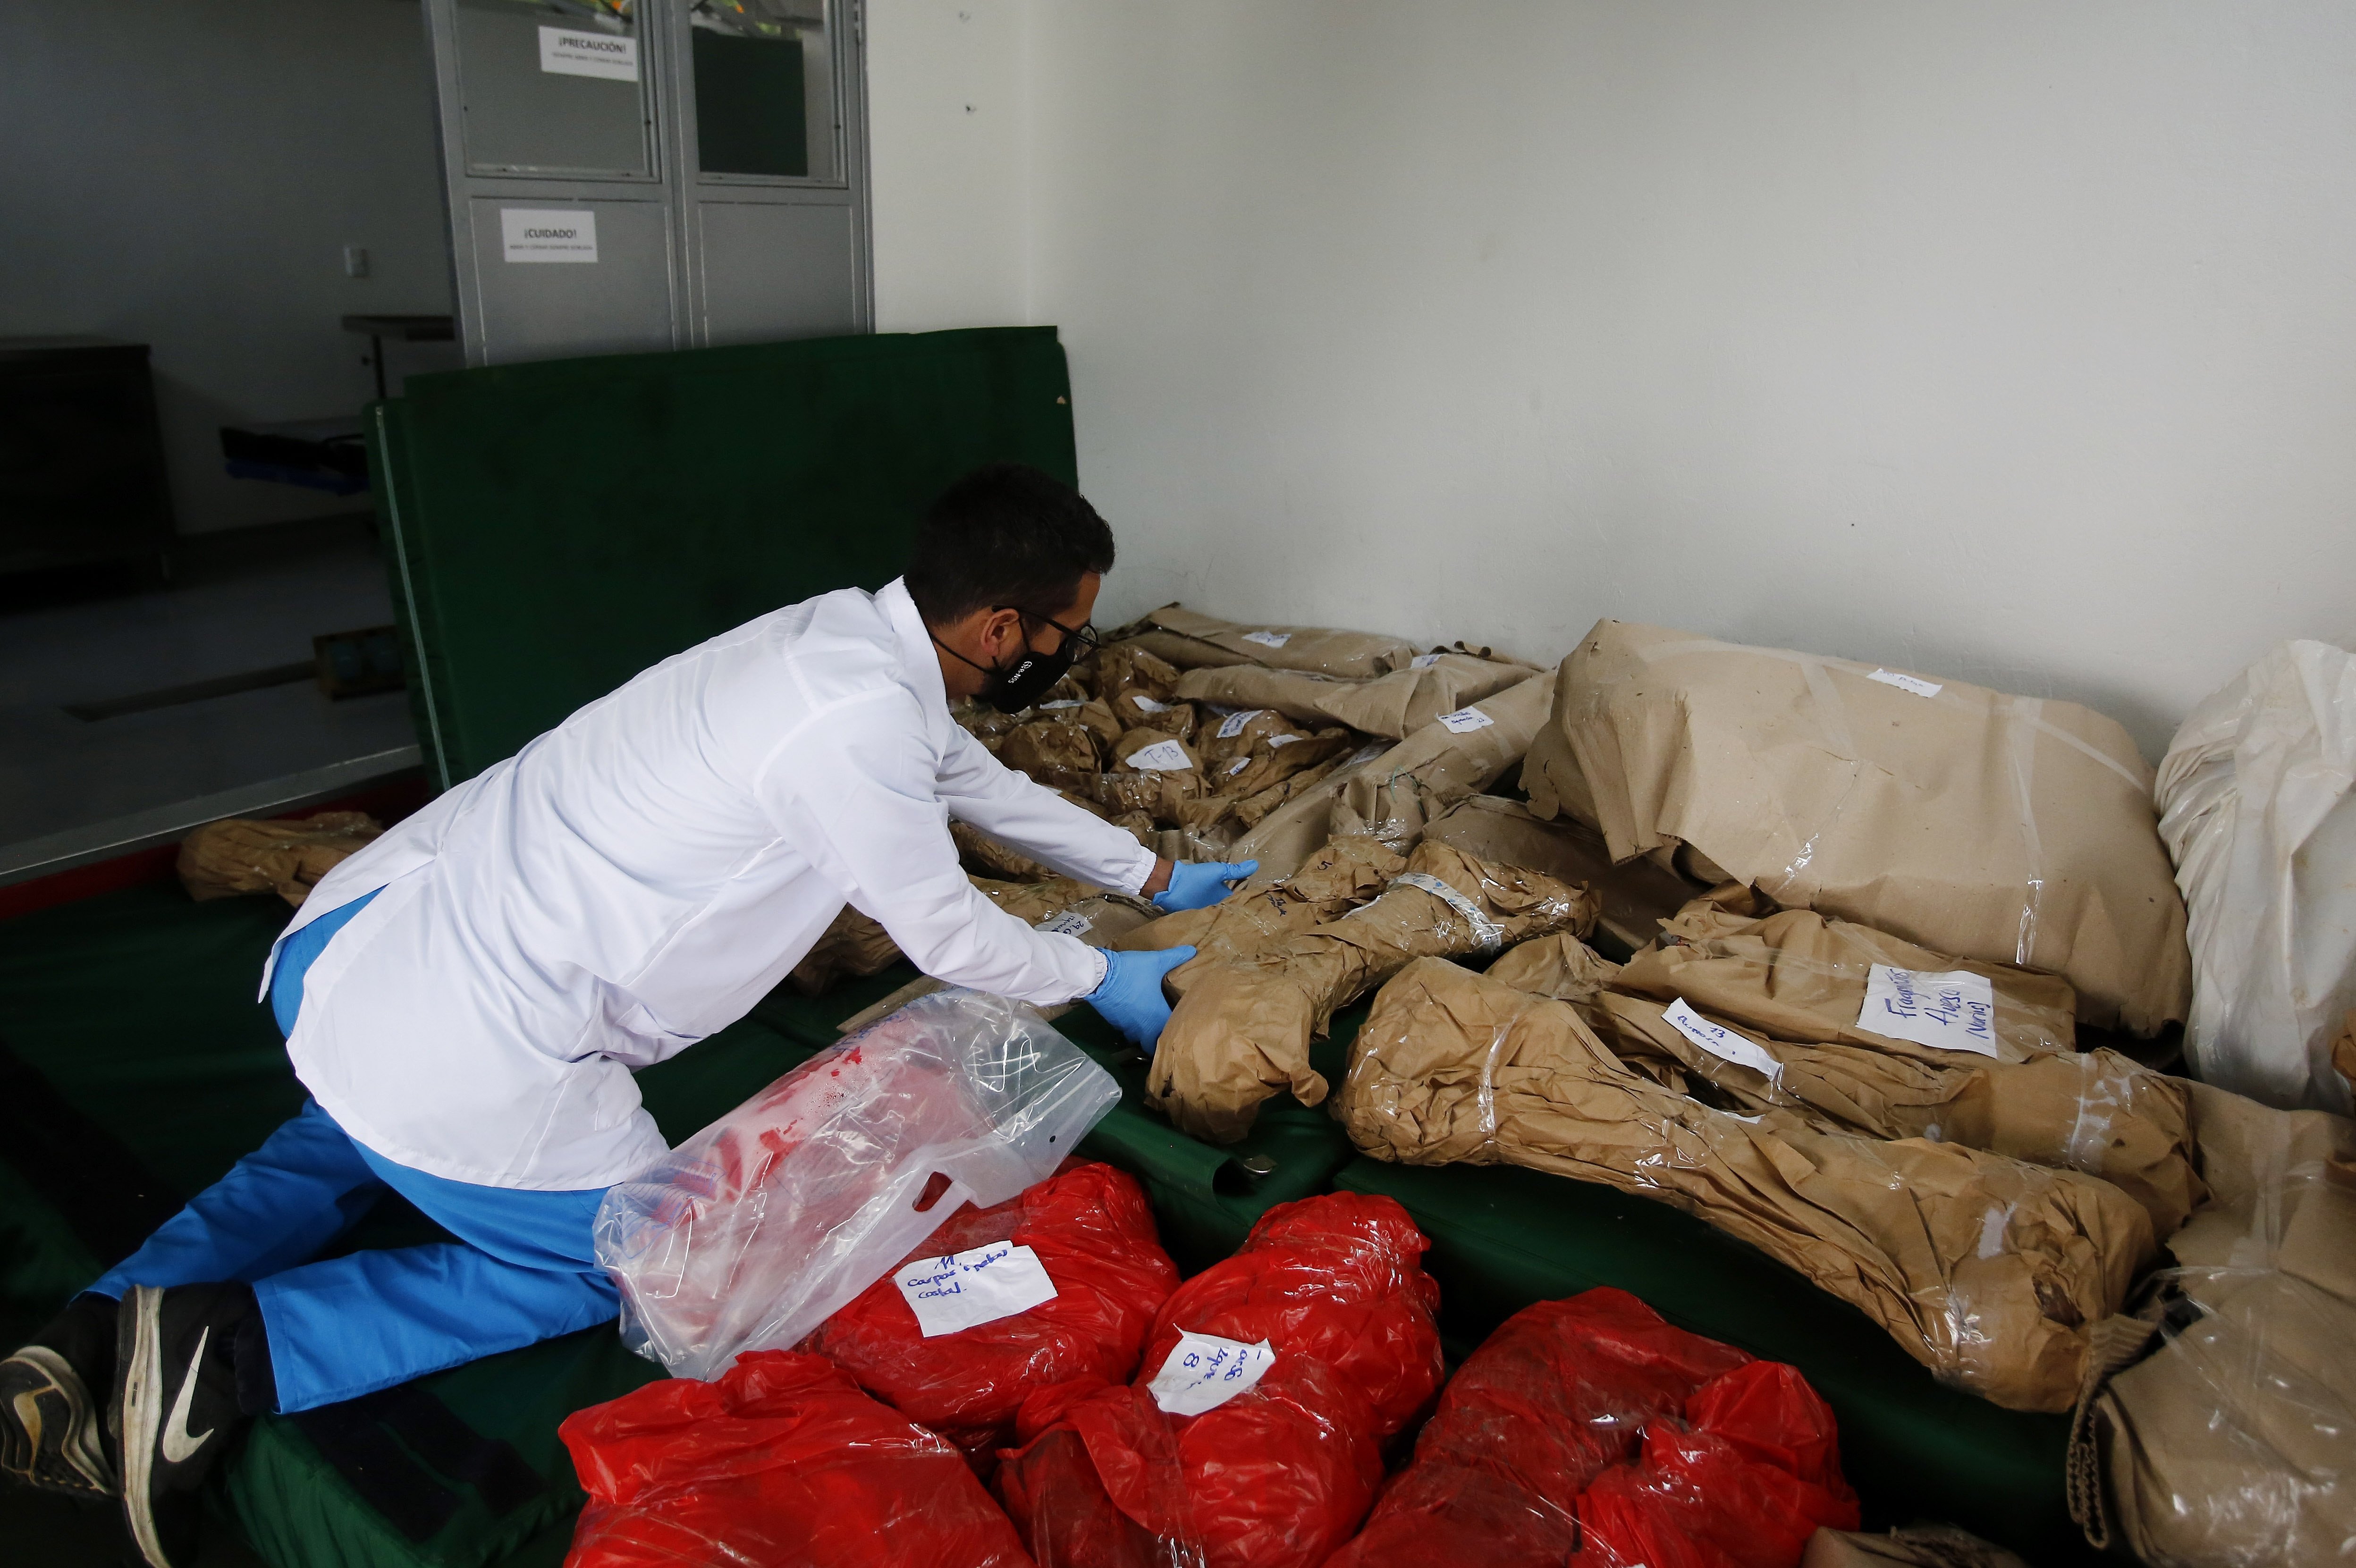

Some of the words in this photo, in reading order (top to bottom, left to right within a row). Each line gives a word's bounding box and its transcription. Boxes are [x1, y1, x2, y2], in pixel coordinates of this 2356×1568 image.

[559, 36, 626, 54] ¡PRECAUCIÓN!
[524, 228, 577, 239] ¡CUIDADO!
[1183, 1352, 1199, 1368] 8
